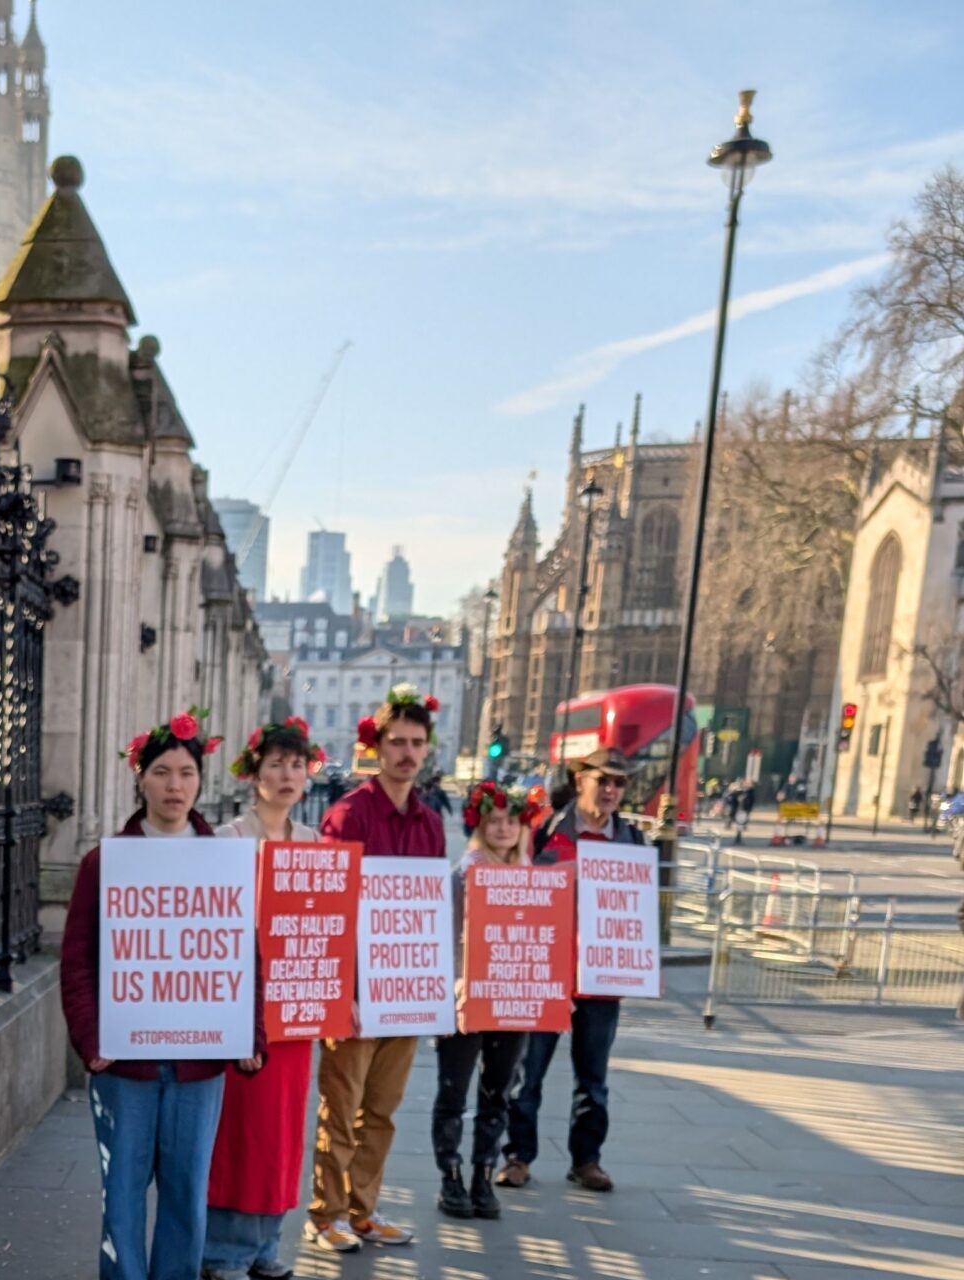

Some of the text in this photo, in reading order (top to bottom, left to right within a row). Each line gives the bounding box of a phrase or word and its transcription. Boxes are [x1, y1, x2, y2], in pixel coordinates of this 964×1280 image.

[273, 848, 350, 871] NO FUTURE IN
[274, 871, 347, 893] UK OIL & GAS
[475, 868, 568, 889] EQUINOR OWNS
[582, 858, 652, 884] ROSEBANK
[361, 875, 445, 901] ROSEBANK
[486, 888, 552, 906] ROSEBANK
[107, 886, 243, 918] ROSEBANK
[596, 888, 639, 912] WON'T
[269, 915, 345, 936] JOBS HALVED
[370, 909, 437, 935] DOESN'T
[597, 917, 643, 941] LOWER
[111, 928, 244, 960] WILL COST
[484, 925, 556, 944] OIL WILL BE
[285, 937, 329, 958] IN LAST
[370, 943, 439, 968] PROTECT
[490, 944, 549, 962] SOLD FOR
[586, 946, 653, 970] OUR BILLS
[270, 959, 340, 980] DECADE BUT
[488, 963, 551, 981] PROFIT ON
[112, 971, 243, 1003] US MONEY
[265, 980, 342, 1002] RENEWABLES
[368, 976, 446, 1003] WORKERS
[470, 981, 566, 1000] INTERNATIONAL
[281, 1002, 326, 1023] UP 29%
[491, 1000, 544, 1018] MARKET
[130, 1030, 223, 1045] #STOPROSEBANK
